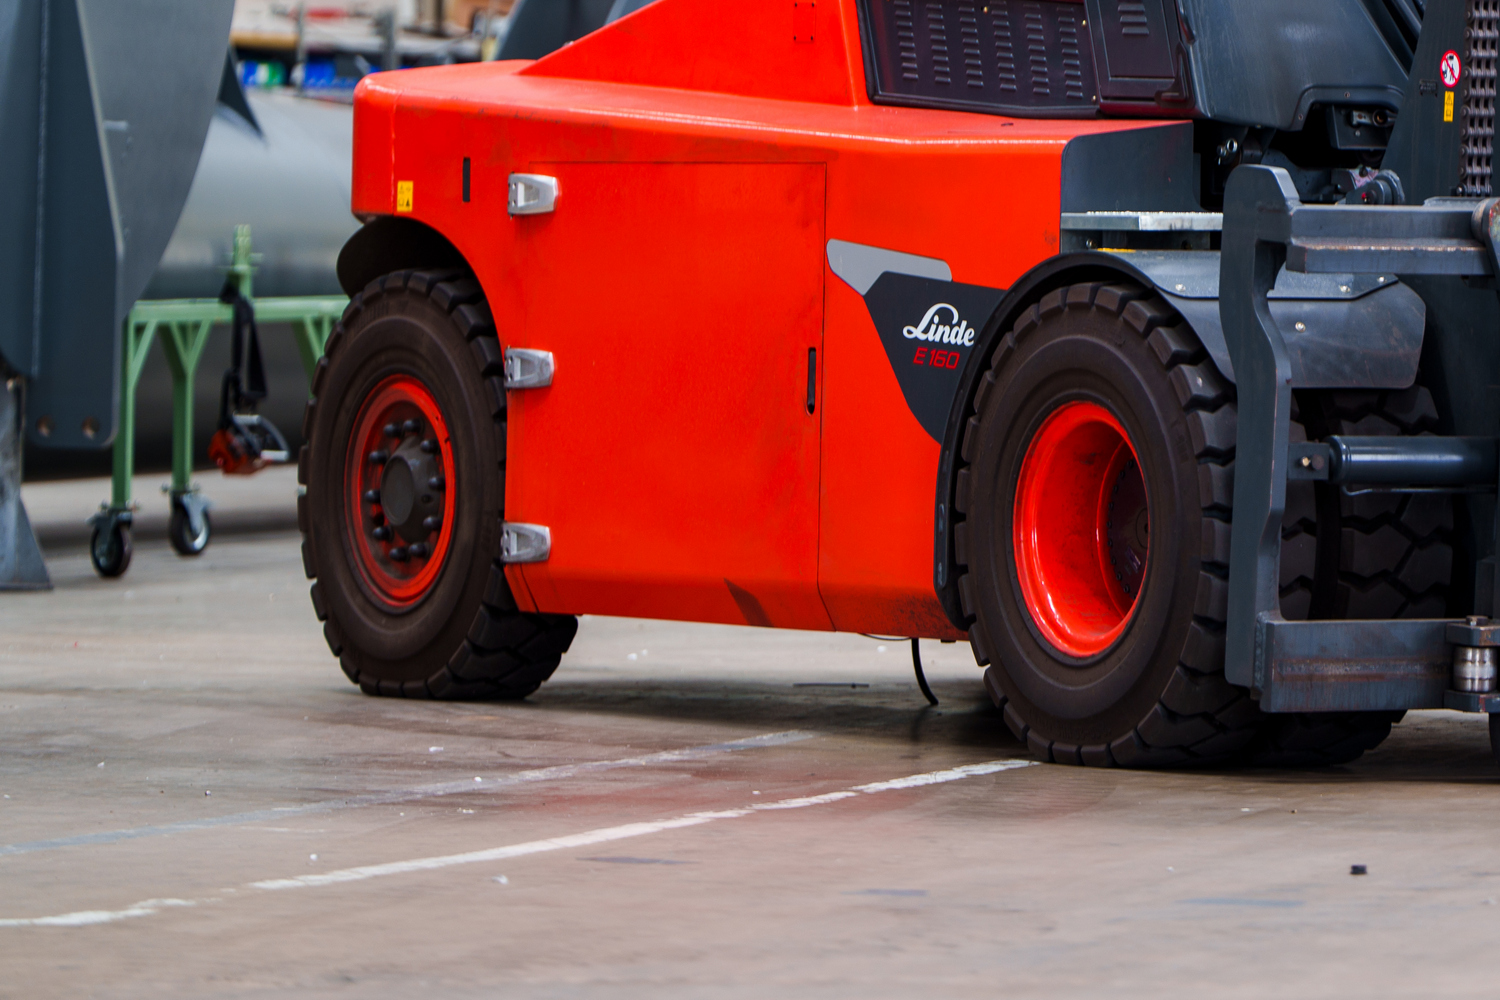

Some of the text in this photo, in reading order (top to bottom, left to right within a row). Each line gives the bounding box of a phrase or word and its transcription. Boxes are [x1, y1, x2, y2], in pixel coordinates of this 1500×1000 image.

[902, 302, 975, 347] Linde
[913, 346, 960, 370] E 160
